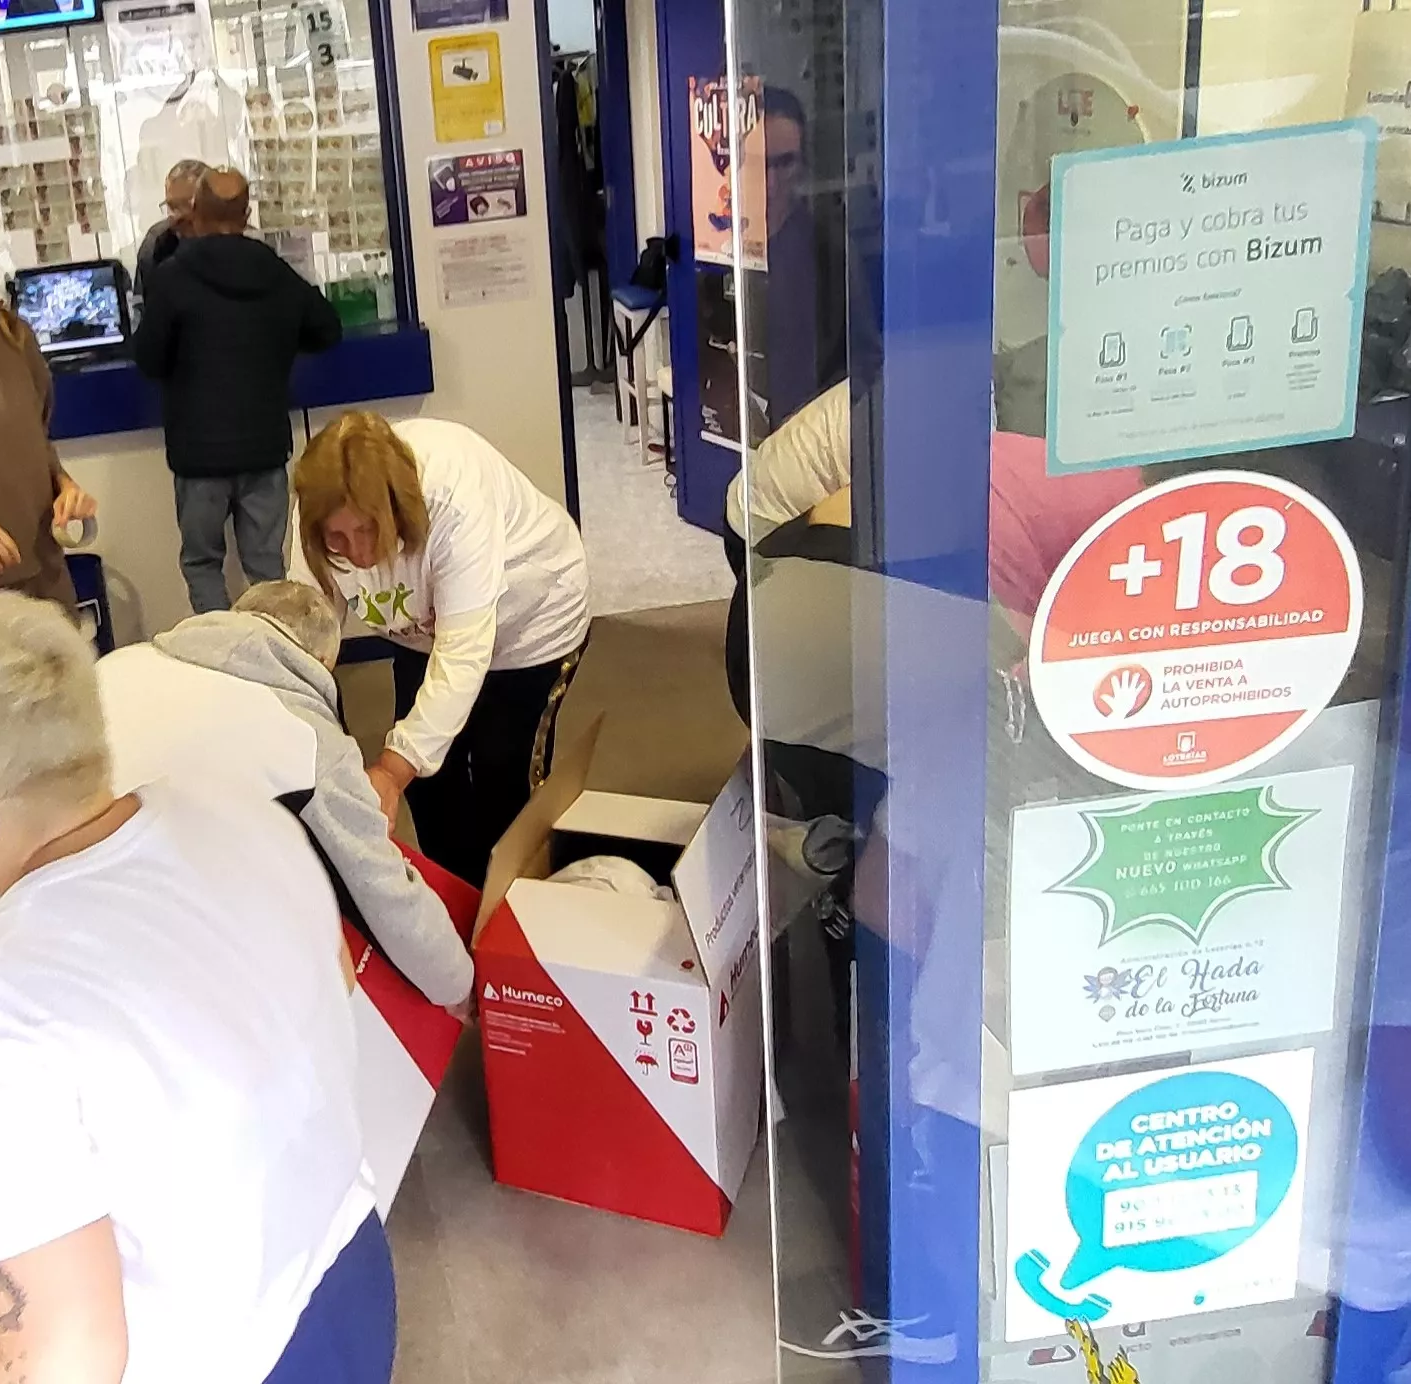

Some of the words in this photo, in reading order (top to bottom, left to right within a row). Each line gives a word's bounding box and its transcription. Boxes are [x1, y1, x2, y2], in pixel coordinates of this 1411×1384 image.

[306, 10, 334, 33] 15
[317, 42, 335, 67] 3
[694, 93, 757, 139] CULTRA
[465, 152, 516, 168] AVISO
[1201, 170, 1248, 190] bizum
[1114, 216, 1171, 245] Paga
[1179, 216, 1194, 238] y
[1200, 205, 1264, 234] cobra
[1273, 201, 1308, 224] tus
[1095, 251, 1188, 286] premios
[1196, 248, 1236, 269] con
[1246, 235, 1323, 262] Bizum
[1108, 505, 1287, 611] +18
[1067, 628, 1124, 649] JUEGA
[1128, 625, 1164, 642] CON
[1170, 609, 1324, 637] RESPONSABILIDAD
[1163, 658, 1244, 677] PROHIBIDA
[1162, 681, 1181, 694] LA
[1186, 675, 1234, 690] VENTA
[1237, 674, 1249, 686] A
[1161, 686, 1292, 710] AUTOPROHIBIDOS
[1121, 820, 1160, 833] PONTE
[1166, 817, 1182, 828] EN
[1188, 807, 1251, 824] CONTACTO
[1154, 835, 1162, 844] A
[1169, 828, 1213, 842] TRAVÉS
[1144, 852, 1157, 861] DE
[1164, 843, 1221, 858] NUESTRO
[1116, 860, 1177, 880] NUEVO
[1129, 964, 1169, 999] El
[1181, 956, 1264, 992] Hada
[1125, 1000, 1150, 1018] de
[1155, 997, 1176, 1014] la
[1181, 987, 1261, 1018] Fortuna
[1130, 1101, 1239, 1134] CENTRO
[1095, 1138, 1134, 1163] DE
[1136, 1117, 1272, 1156] ATENCIÓN
[1102, 1160, 1140, 1182] AL
[1144, 1142, 1262, 1176] USUARIO
